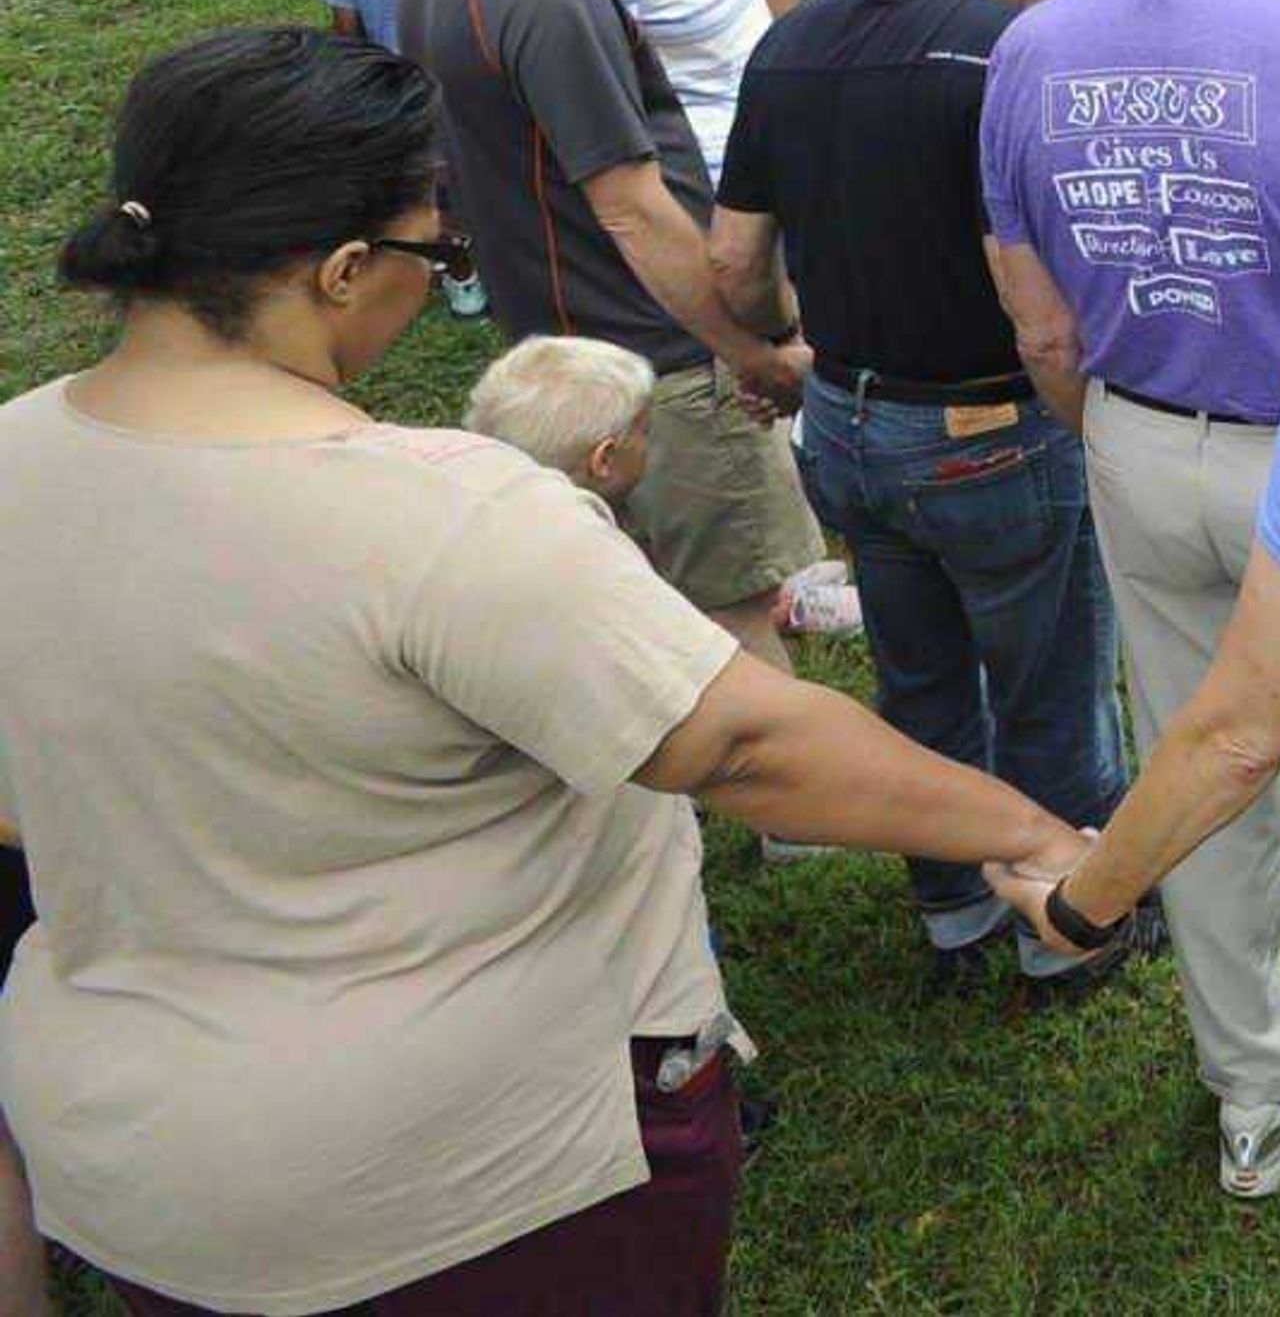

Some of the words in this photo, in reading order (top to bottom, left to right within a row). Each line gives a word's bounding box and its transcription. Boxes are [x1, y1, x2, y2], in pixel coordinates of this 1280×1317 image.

[1067, 78, 1227, 128] JESUS
[1086, 139, 1173, 168] Gives
[1181, 139, 1218, 171] Us
[1067, 178, 1142, 208] HOPE
